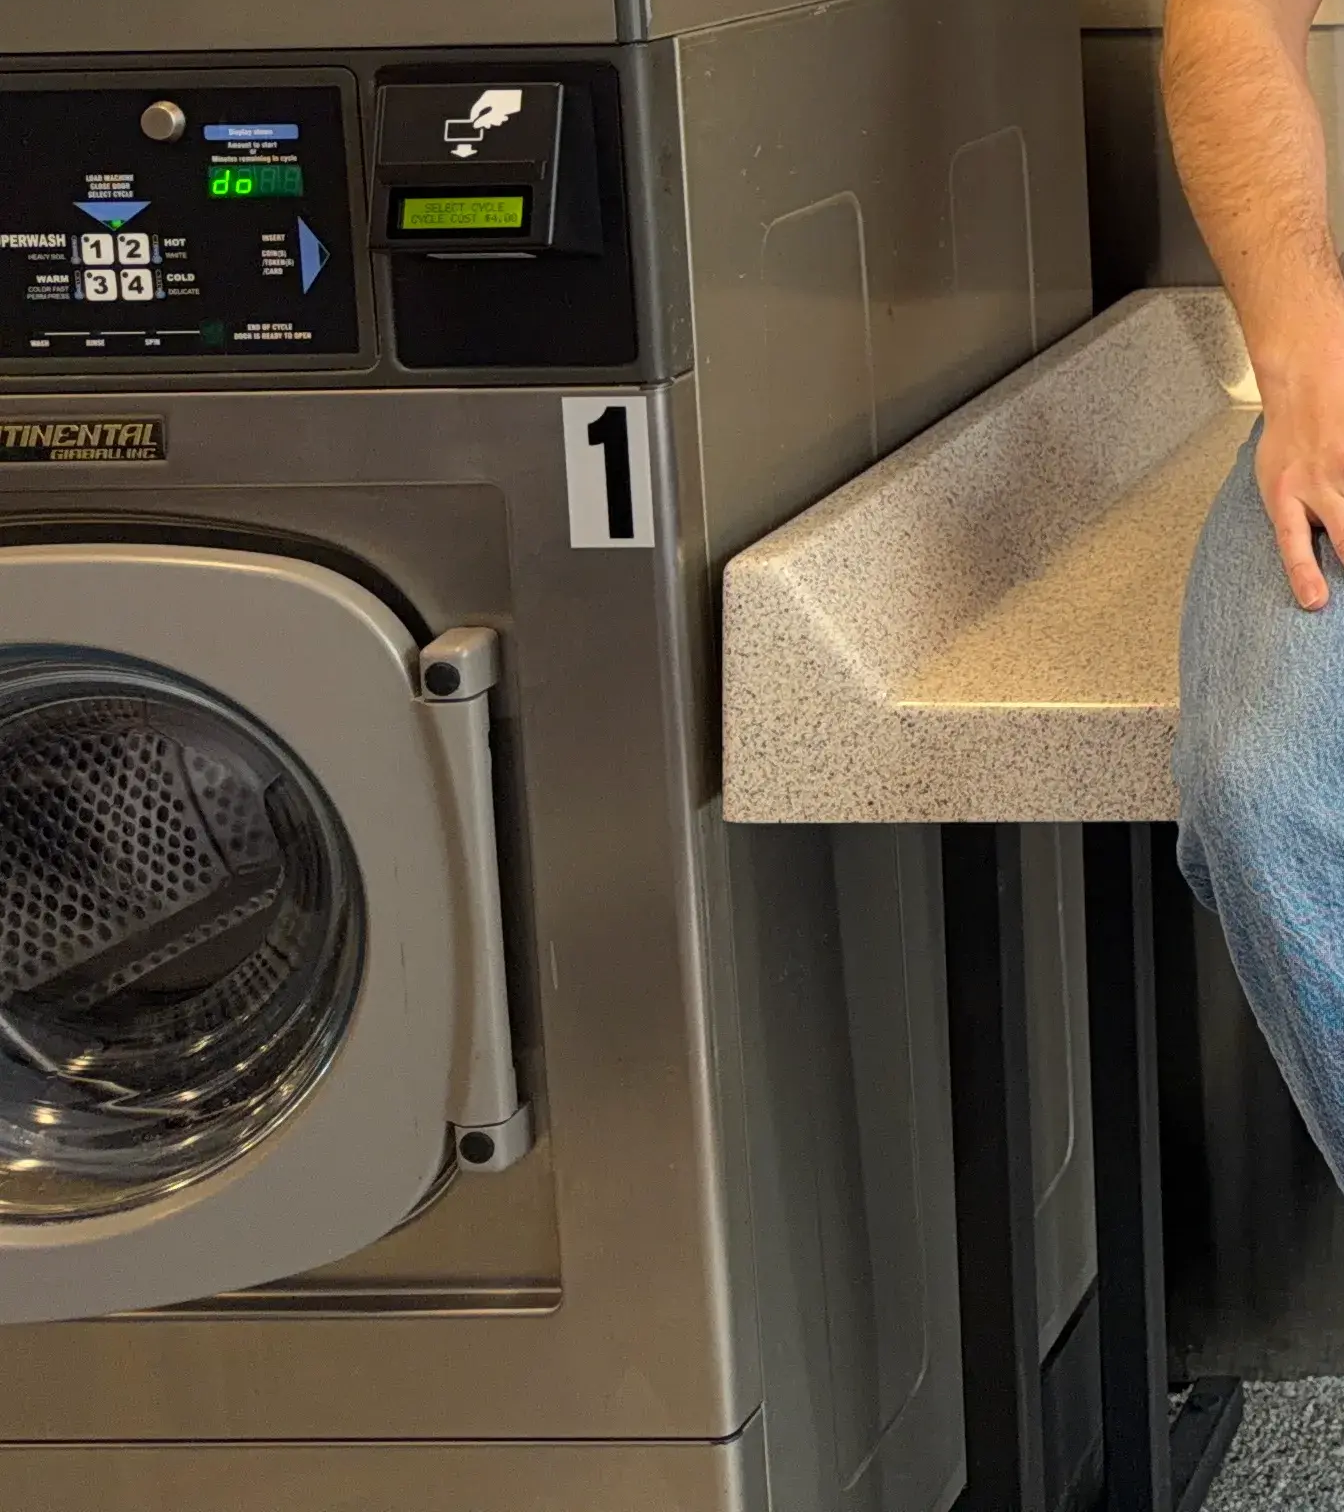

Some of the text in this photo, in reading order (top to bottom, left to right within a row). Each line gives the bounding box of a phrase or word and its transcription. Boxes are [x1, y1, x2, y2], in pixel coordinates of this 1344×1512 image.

[88, 190, 111, 198] SELECT
[425, 202, 505, 212] SELECT CYCLE
[0, 234, 66, 248] PERWASH
[90, 240, 102, 258] 1
[126, 240, 142, 258] 2
[164, 239, 186, 247] HOT
[36, 275, 69, 283] WARM
[93, 276, 108, 295] 3
[128, 276, 144, 294] 4
[166, 273, 195, 282] COLD
[0, 424, 157, 447] TINENTAL
[588, 406, 634, 540] 1
